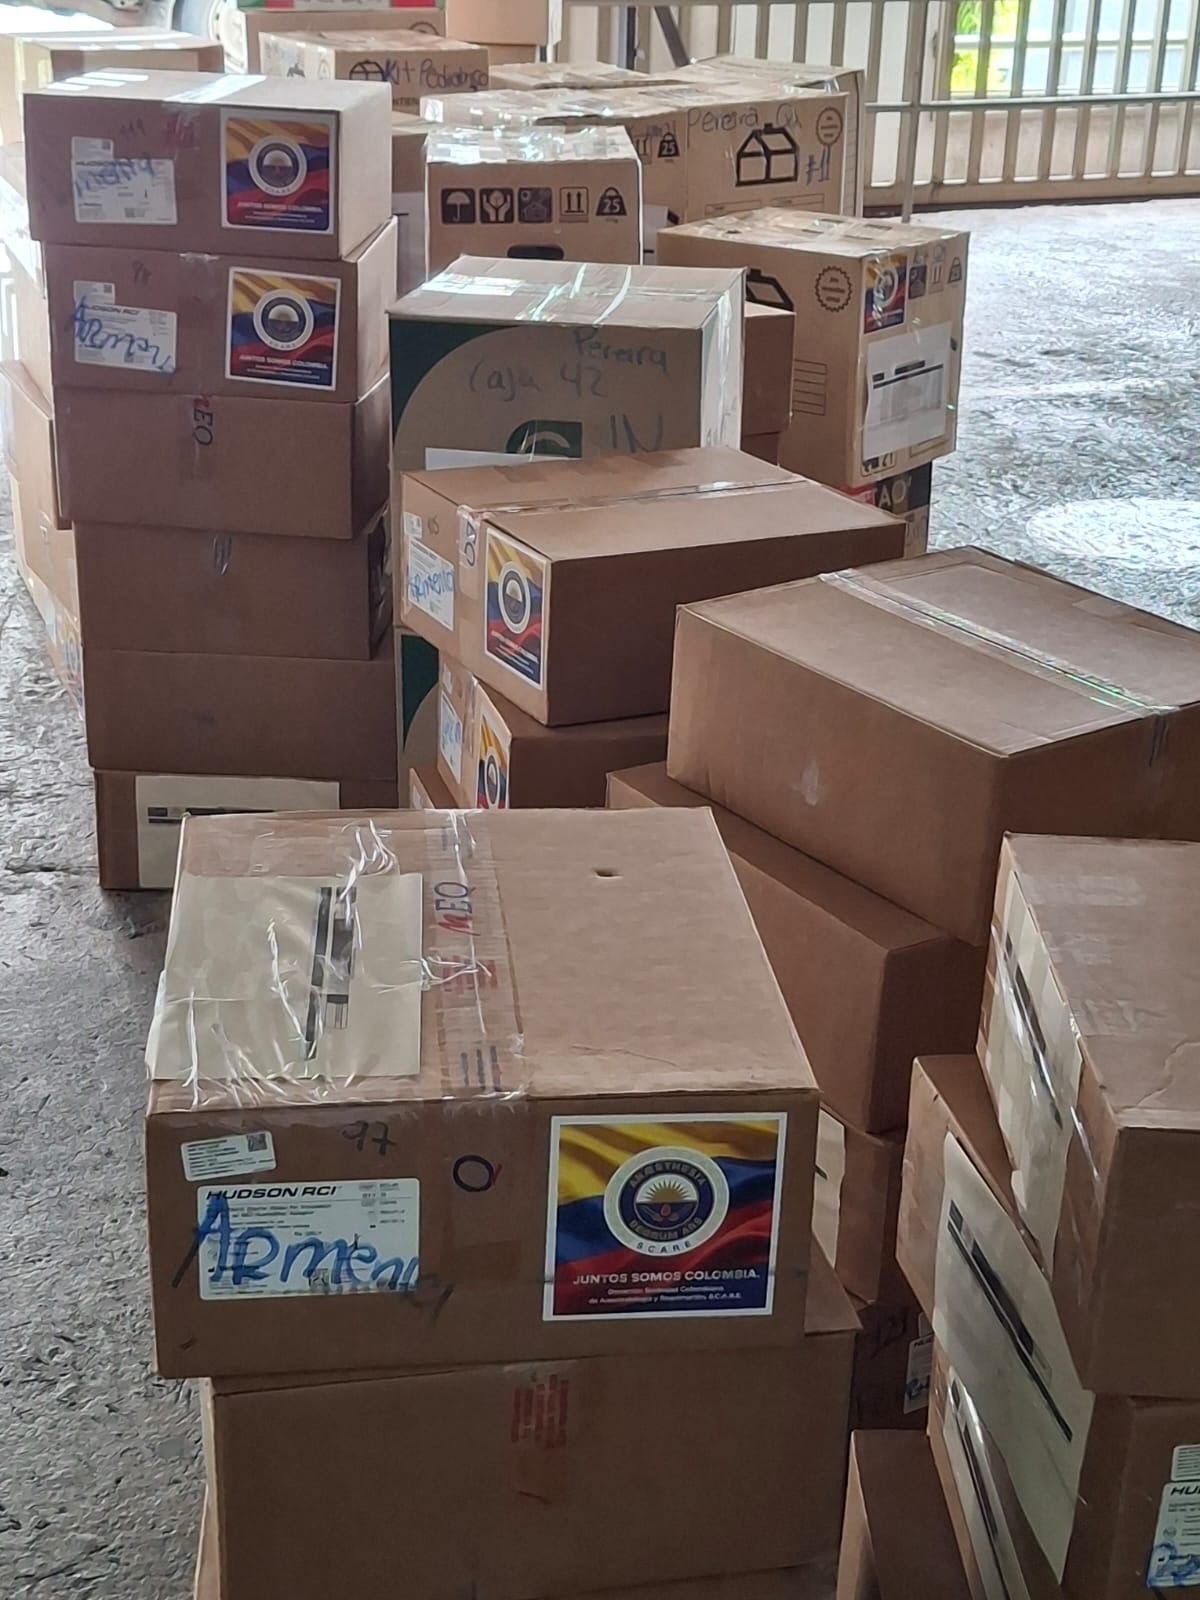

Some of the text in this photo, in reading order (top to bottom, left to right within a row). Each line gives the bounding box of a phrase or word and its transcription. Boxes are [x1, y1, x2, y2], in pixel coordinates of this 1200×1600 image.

[206, 1185, 338, 1201] HUDSON RCI
[573, 1272, 628, 1285] JUNTOS
[631, 1270, 681, 1283] SOMOS
[1170, 1485, 1200, 1496] HU
